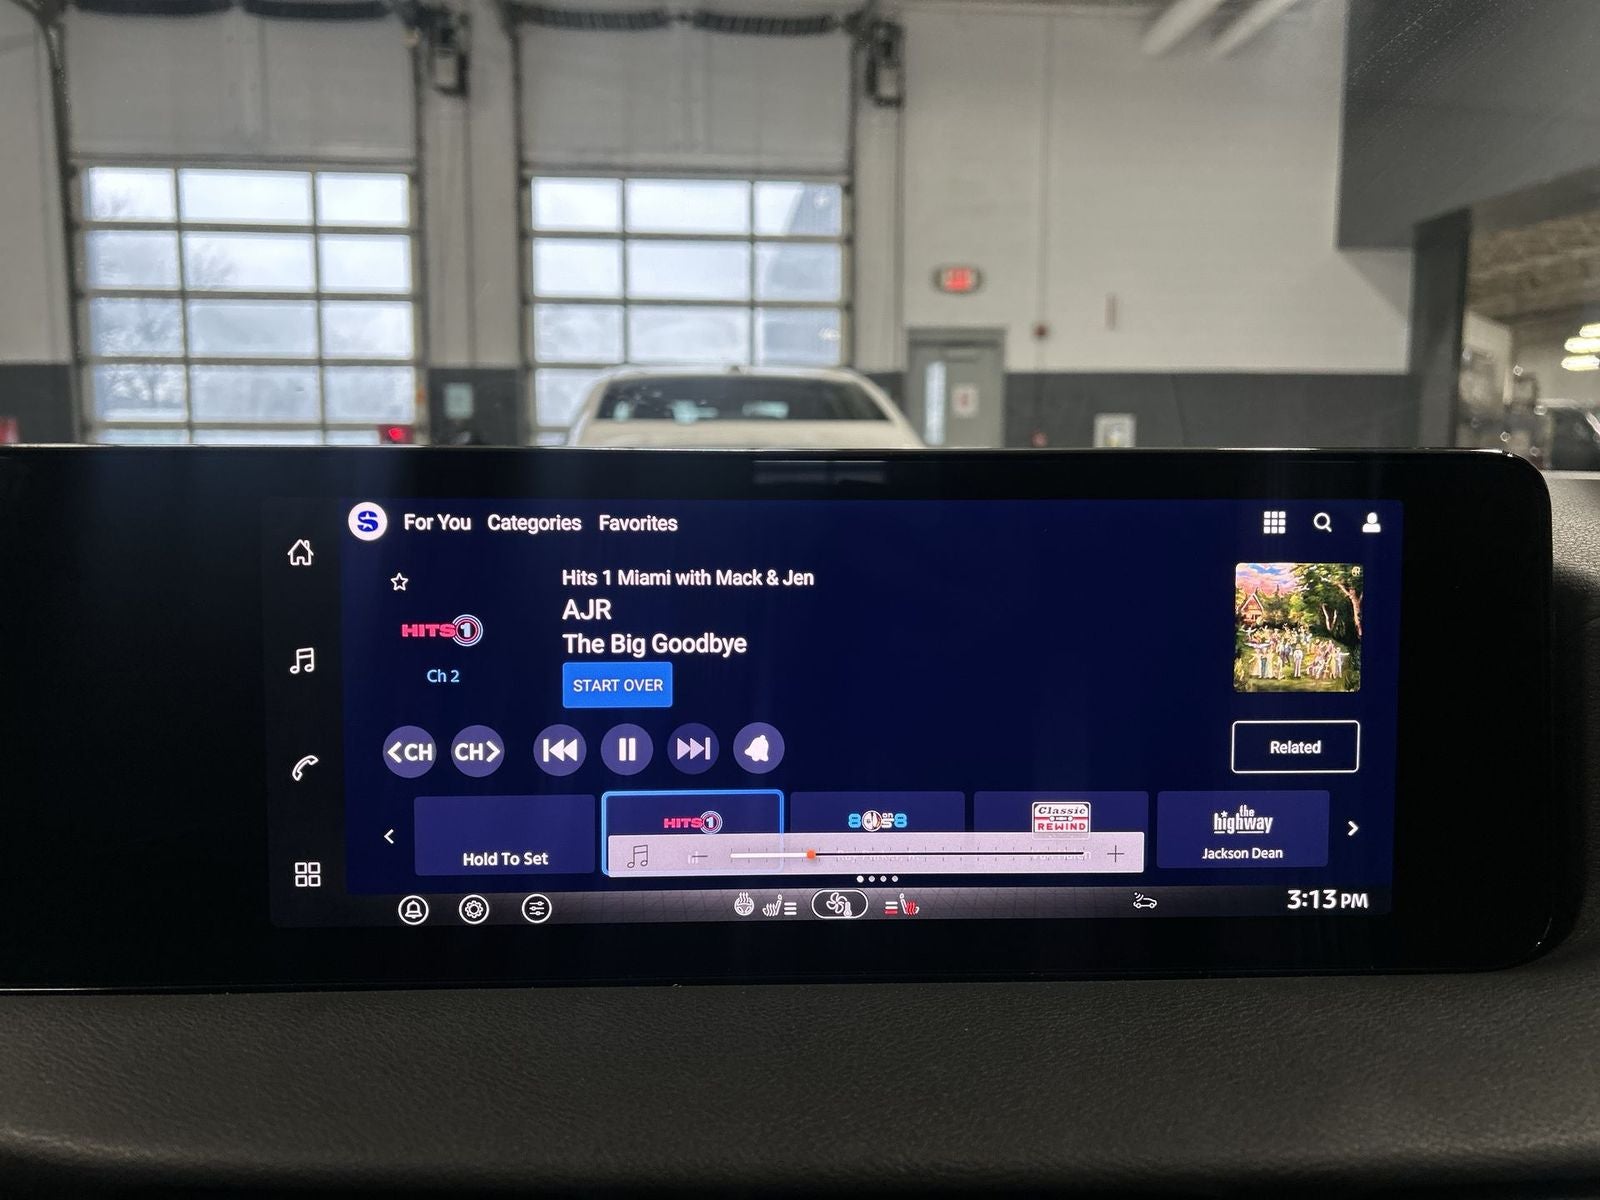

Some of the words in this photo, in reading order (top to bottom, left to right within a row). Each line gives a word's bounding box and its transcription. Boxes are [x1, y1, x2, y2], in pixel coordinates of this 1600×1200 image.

[404, 514, 433, 531] For
[437, 514, 471, 530] You
[488, 514, 582, 534] Categories
[600, 515, 678, 531] Favorites
[562, 570, 597, 586] Hits
[603, 570, 610, 585] 1
[618, 569, 671, 585] Miami
[675, 569, 711, 585] with
[716, 569, 762, 585] Mack
[766, 569, 779, 585] &
[783, 570, 814, 585] Jen
[562, 599, 611, 620] AJR
[562, 633, 605, 653] The
[611, 634, 646, 658] Big
[652, 633, 747, 658] Goodbye
[427, 669, 446, 682] Ch
[451, 670, 459, 682] 2
[574, 679, 620, 692] START
[624, 679, 663, 691] OVER
[1271, 740, 1321, 754] Related
[1038, 806, 1086, 815] Classic
[1239, 805, 1256, 817] the
[1037, 822, 1086, 831] REWIND
[1213, 811, 1273, 834] highway
[463, 852, 497, 866] Hold
[501, 852, 520, 865] To
[524, 852, 548, 865] Set
[1202, 848, 1249, 859] Jackson
[1252, 848, 1283, 859] Dean
[1288, 890, 1336, 909] 3:13
[1341, 894, 1368, 908] PM
